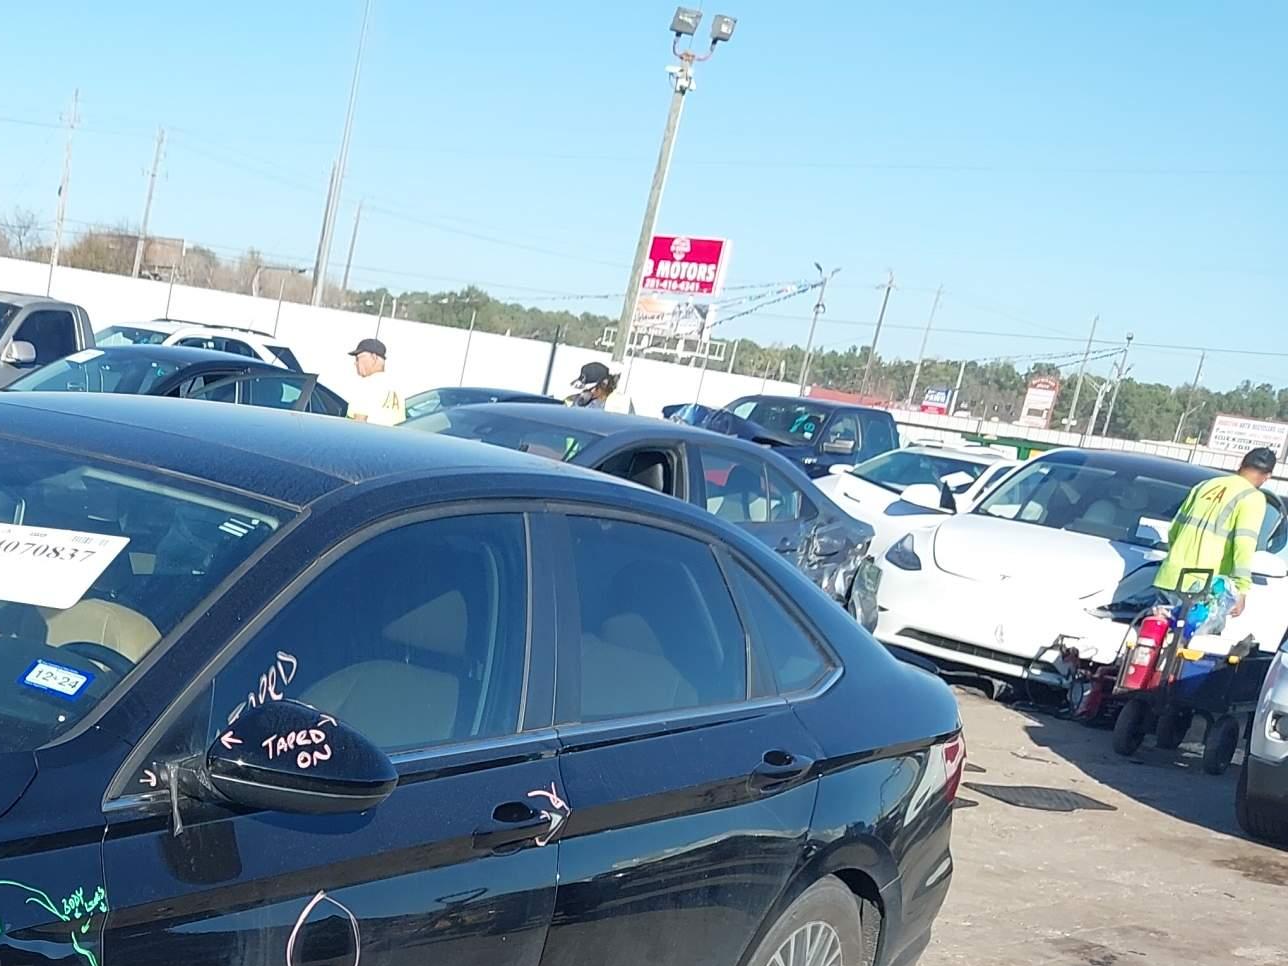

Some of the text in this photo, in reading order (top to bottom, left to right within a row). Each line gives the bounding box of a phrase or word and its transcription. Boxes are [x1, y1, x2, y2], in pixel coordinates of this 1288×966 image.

[656, 259, 716, 282] MOTORS
[261, 729, 326, 760] TAPED
[296, 744, 332, 769] ON
